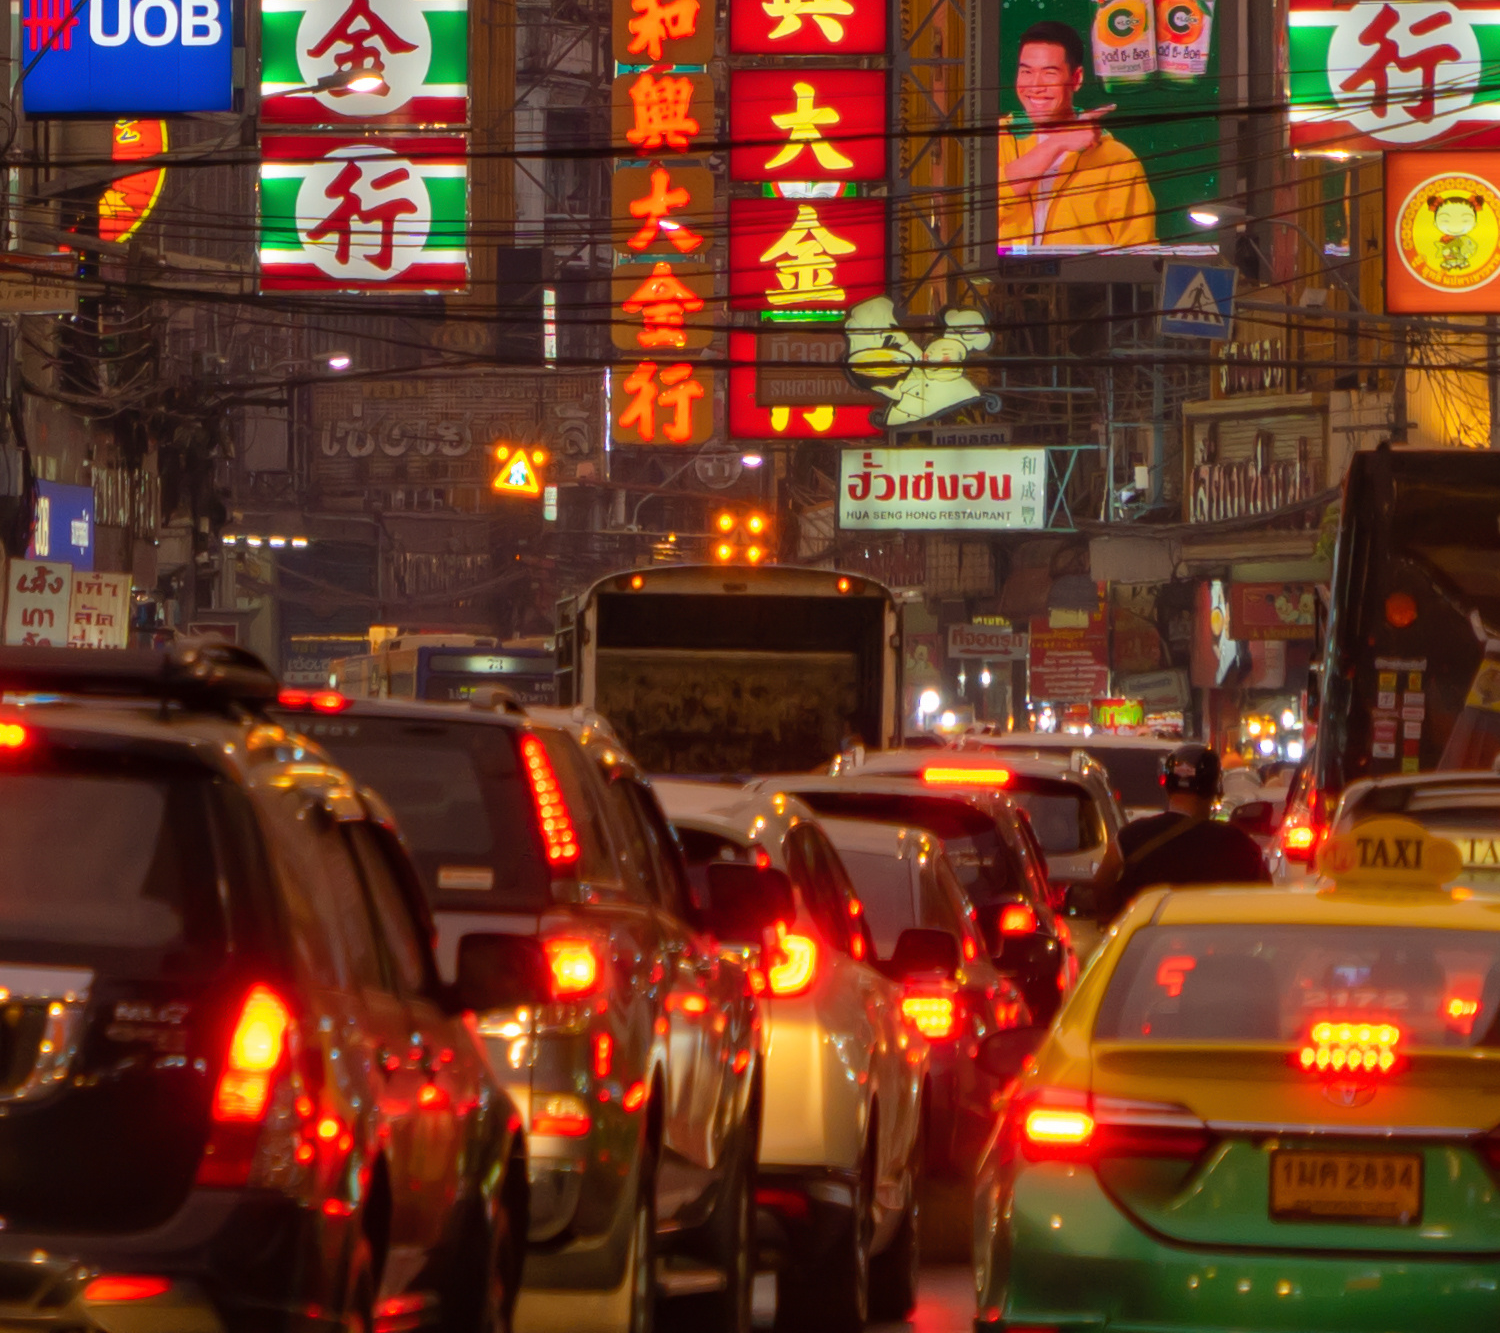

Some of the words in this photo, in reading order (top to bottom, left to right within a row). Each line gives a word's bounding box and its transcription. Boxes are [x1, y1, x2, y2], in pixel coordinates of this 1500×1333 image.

[847, 452, 1012, 502] ฮั่วเซ่งฮง
[846, 509, 869, 522] HUA
[873, 509, 903, 522] SENG
[905, 509, 937, 522] HONG
[939, 509, 1013, 523] RESTAURANT
[485, 657, 503, 671] 73
[1356, 835, 1423, 869] TAXI
